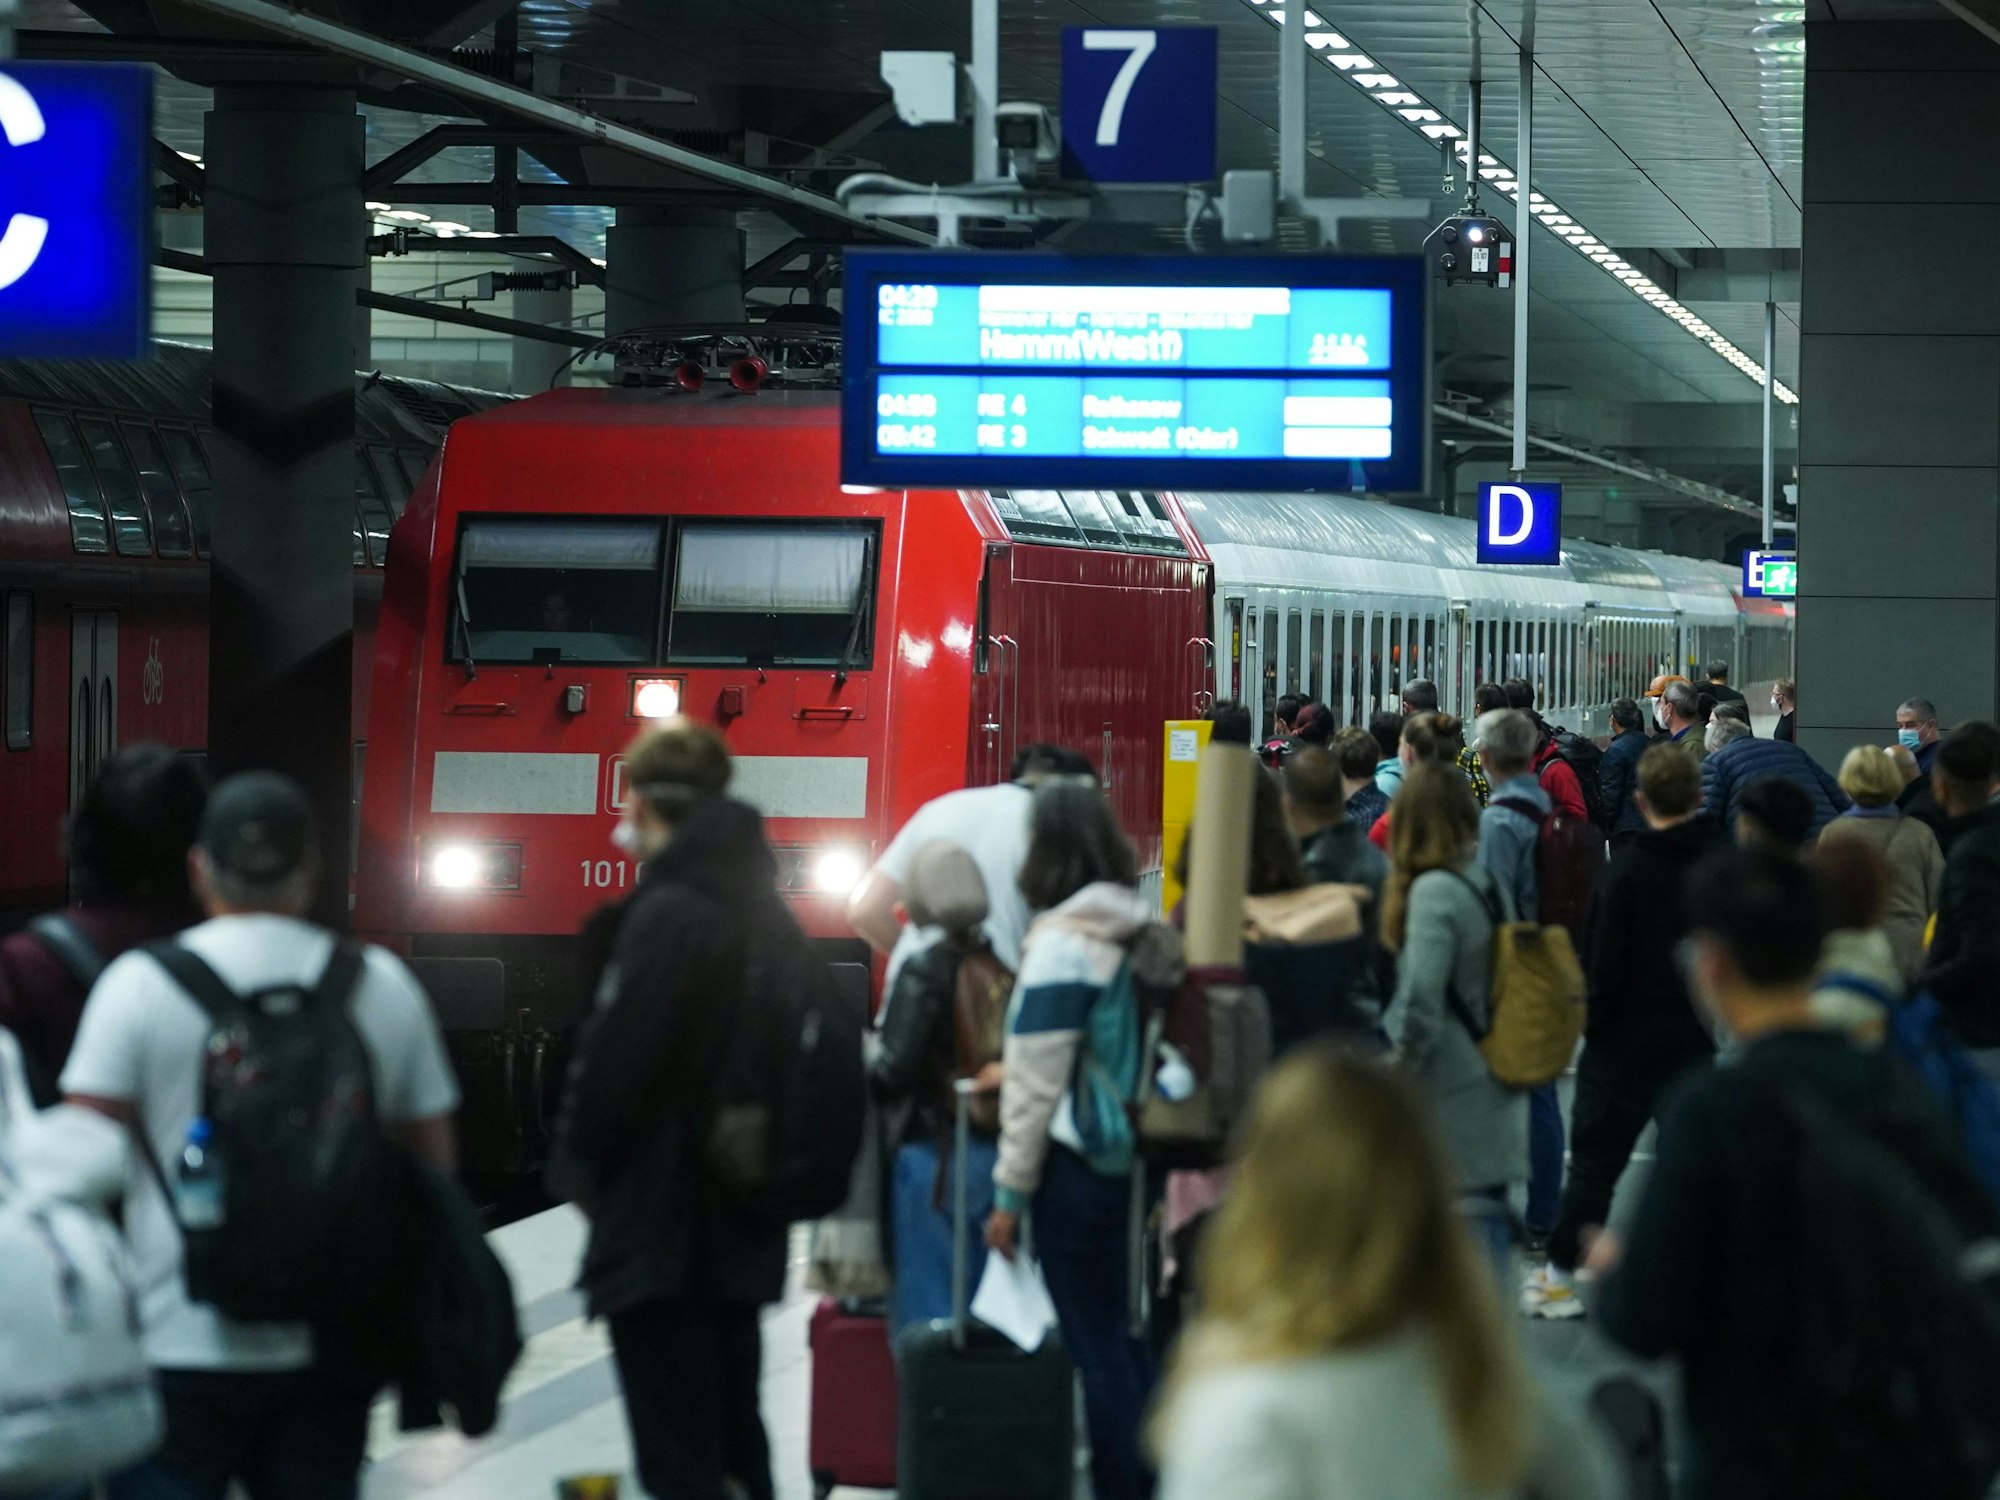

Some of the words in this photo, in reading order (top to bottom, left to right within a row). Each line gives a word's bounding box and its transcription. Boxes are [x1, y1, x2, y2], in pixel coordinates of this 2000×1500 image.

[1081, 30, 1156, 146] 7
[1010, 394, 1027, 417] 4
[1010, 424, 1027, 448] 3
[1488, 485, 1534, 546] D
[581, 859, 625, 888] 101
